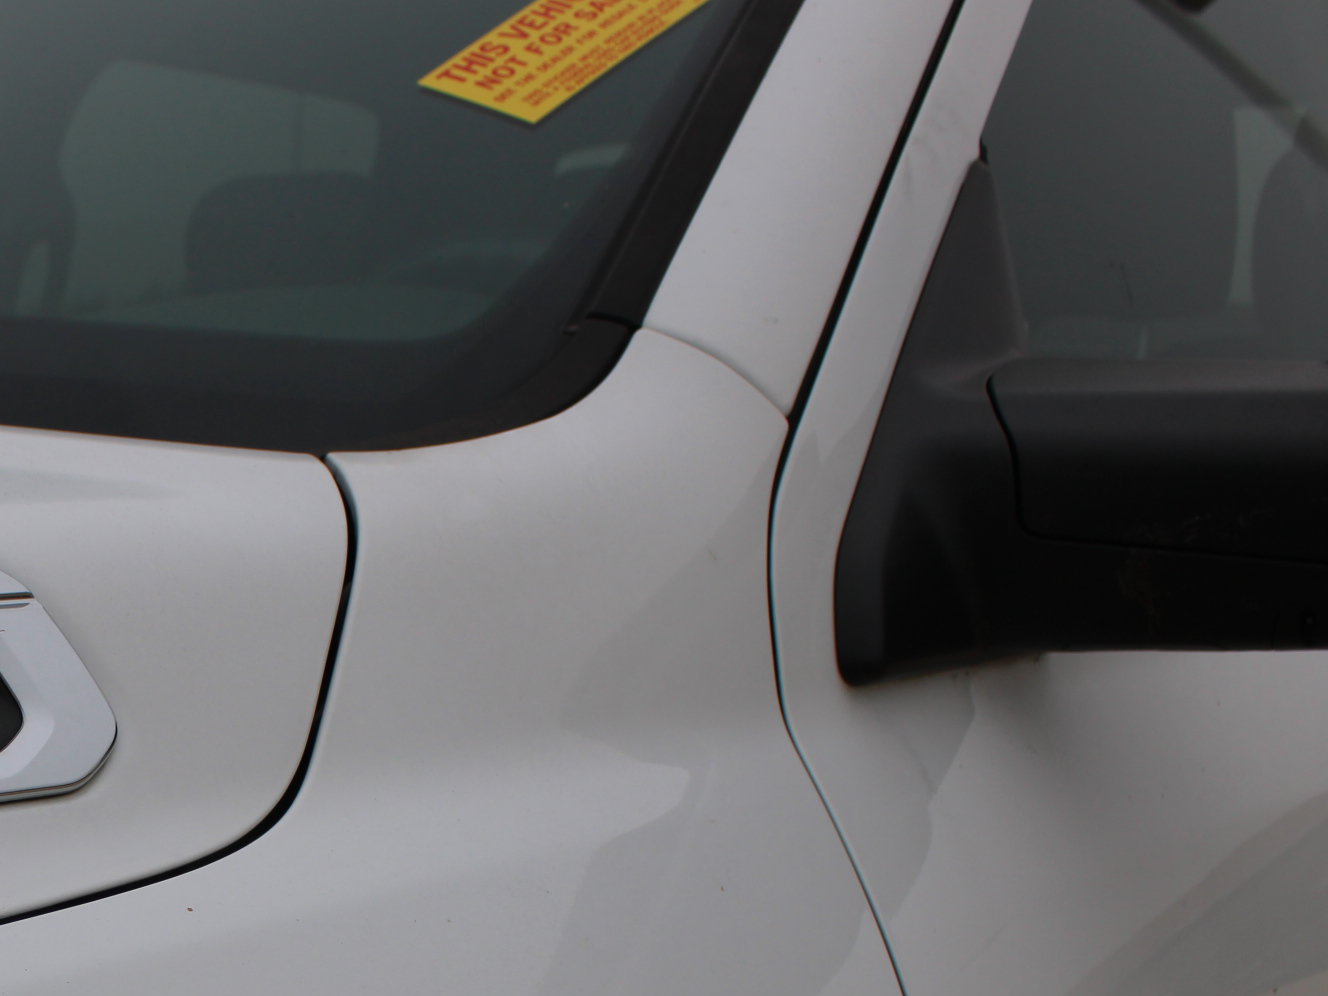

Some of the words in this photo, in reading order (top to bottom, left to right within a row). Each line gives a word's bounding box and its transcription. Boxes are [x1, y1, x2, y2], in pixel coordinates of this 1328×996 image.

[435, 41, 511, 84] THIS
[497, 0, 576, 41] VEHI
[474, 54, 528, 91] NOT
[524, 21, 579, 56] FOR
[573, 0, 625, 22] SA
